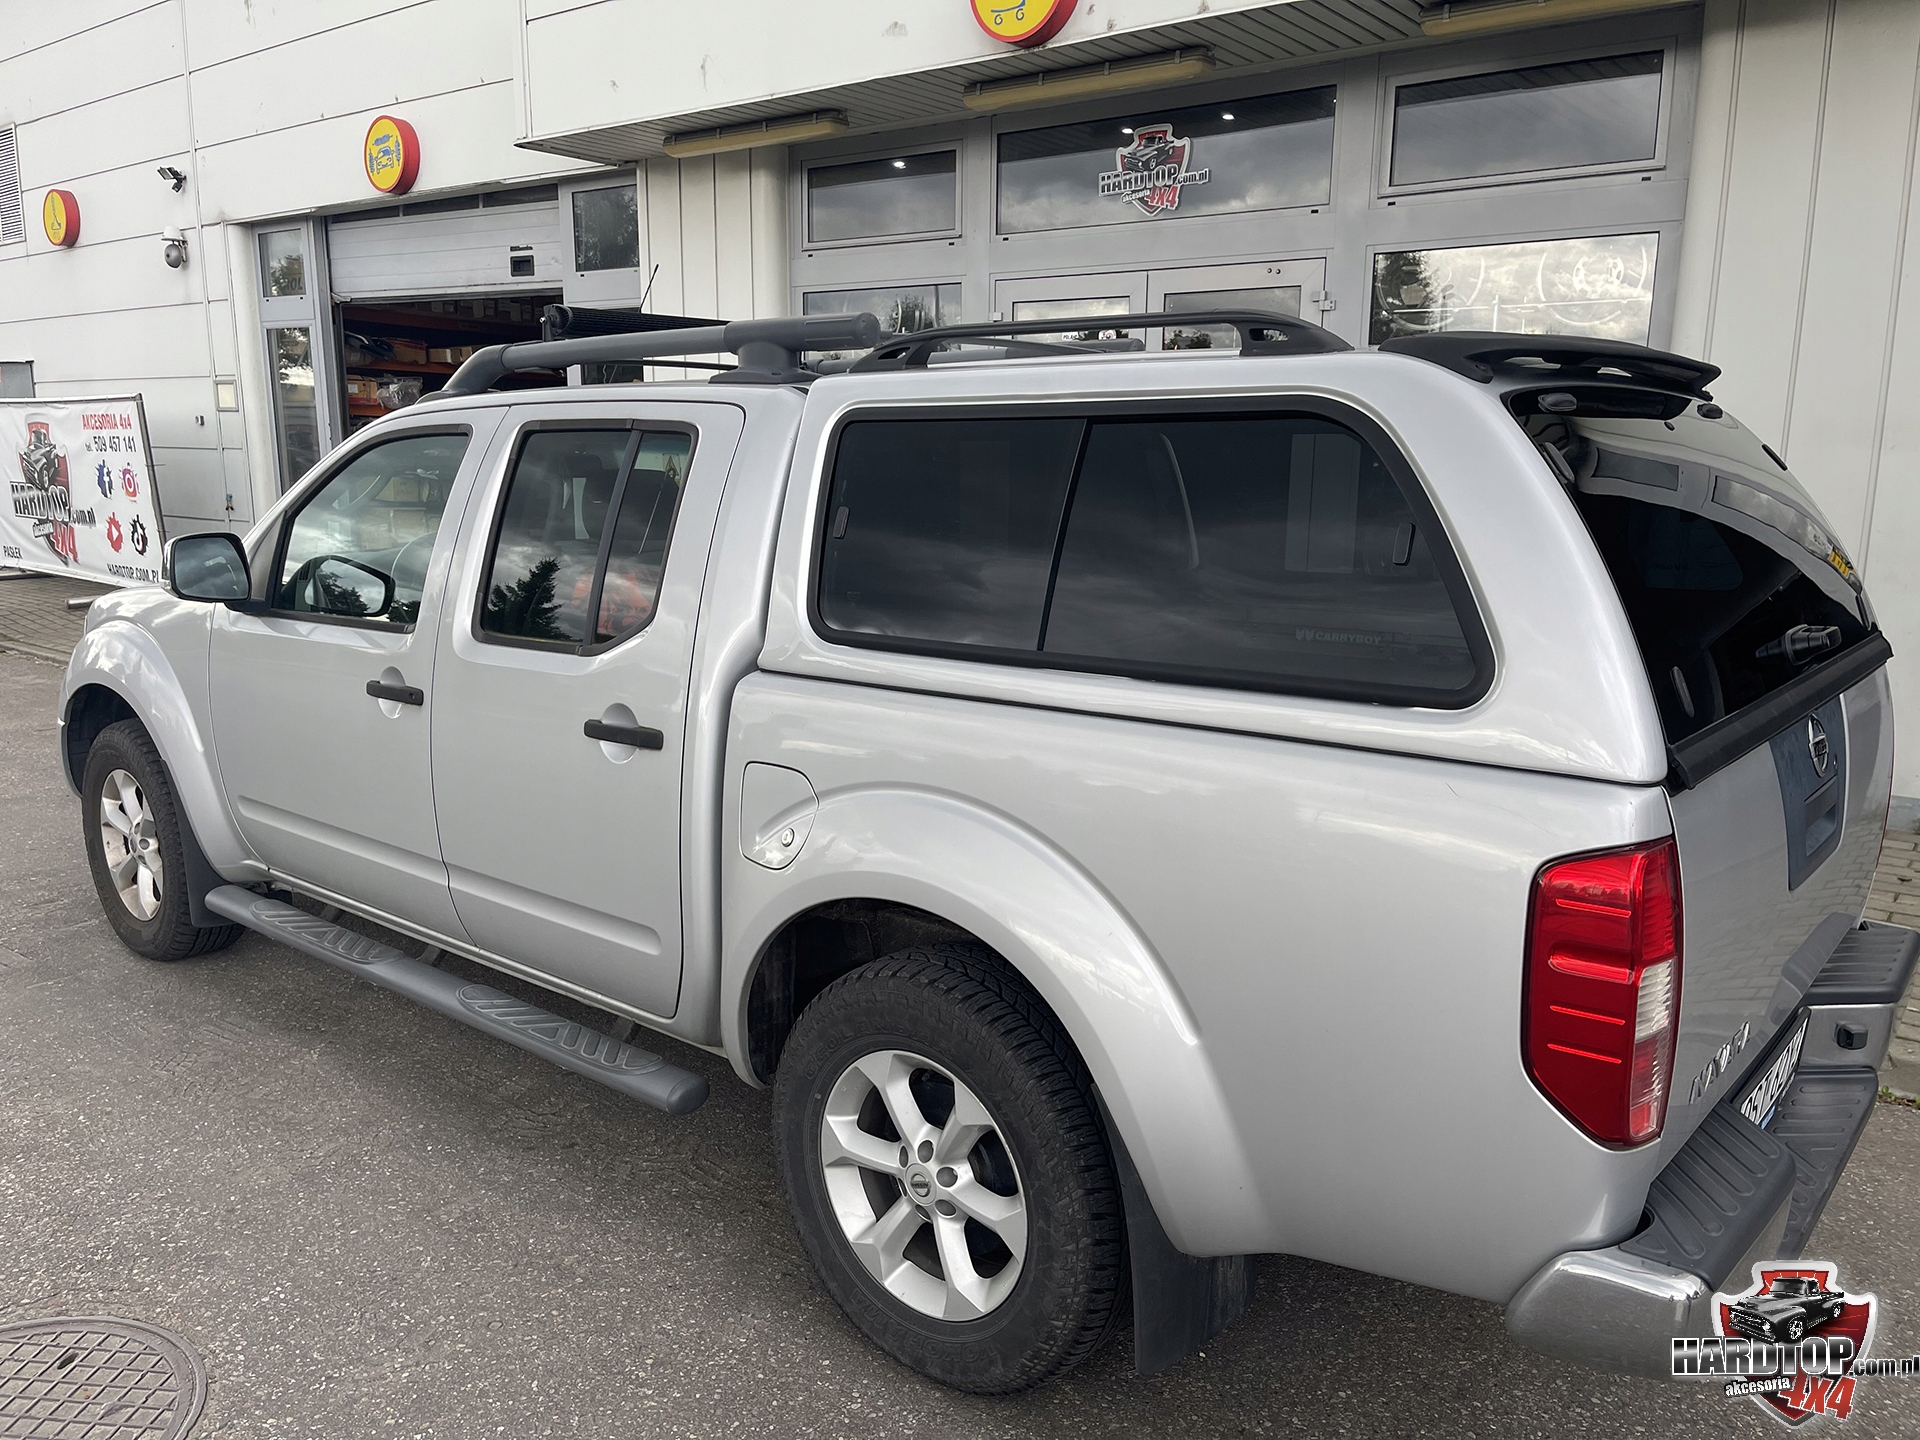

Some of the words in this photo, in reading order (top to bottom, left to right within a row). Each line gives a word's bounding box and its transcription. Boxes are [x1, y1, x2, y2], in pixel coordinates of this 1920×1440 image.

[82, 413, 118, 430] AKCESORIA
[119, 413, 132, 430] 4x4
[93, 435, 107, 452] 509
[109, 435, 121, 452] 457
[123, 435, 136, 452] 141
[1315, 631, 1381, 644] CARRYBOY
